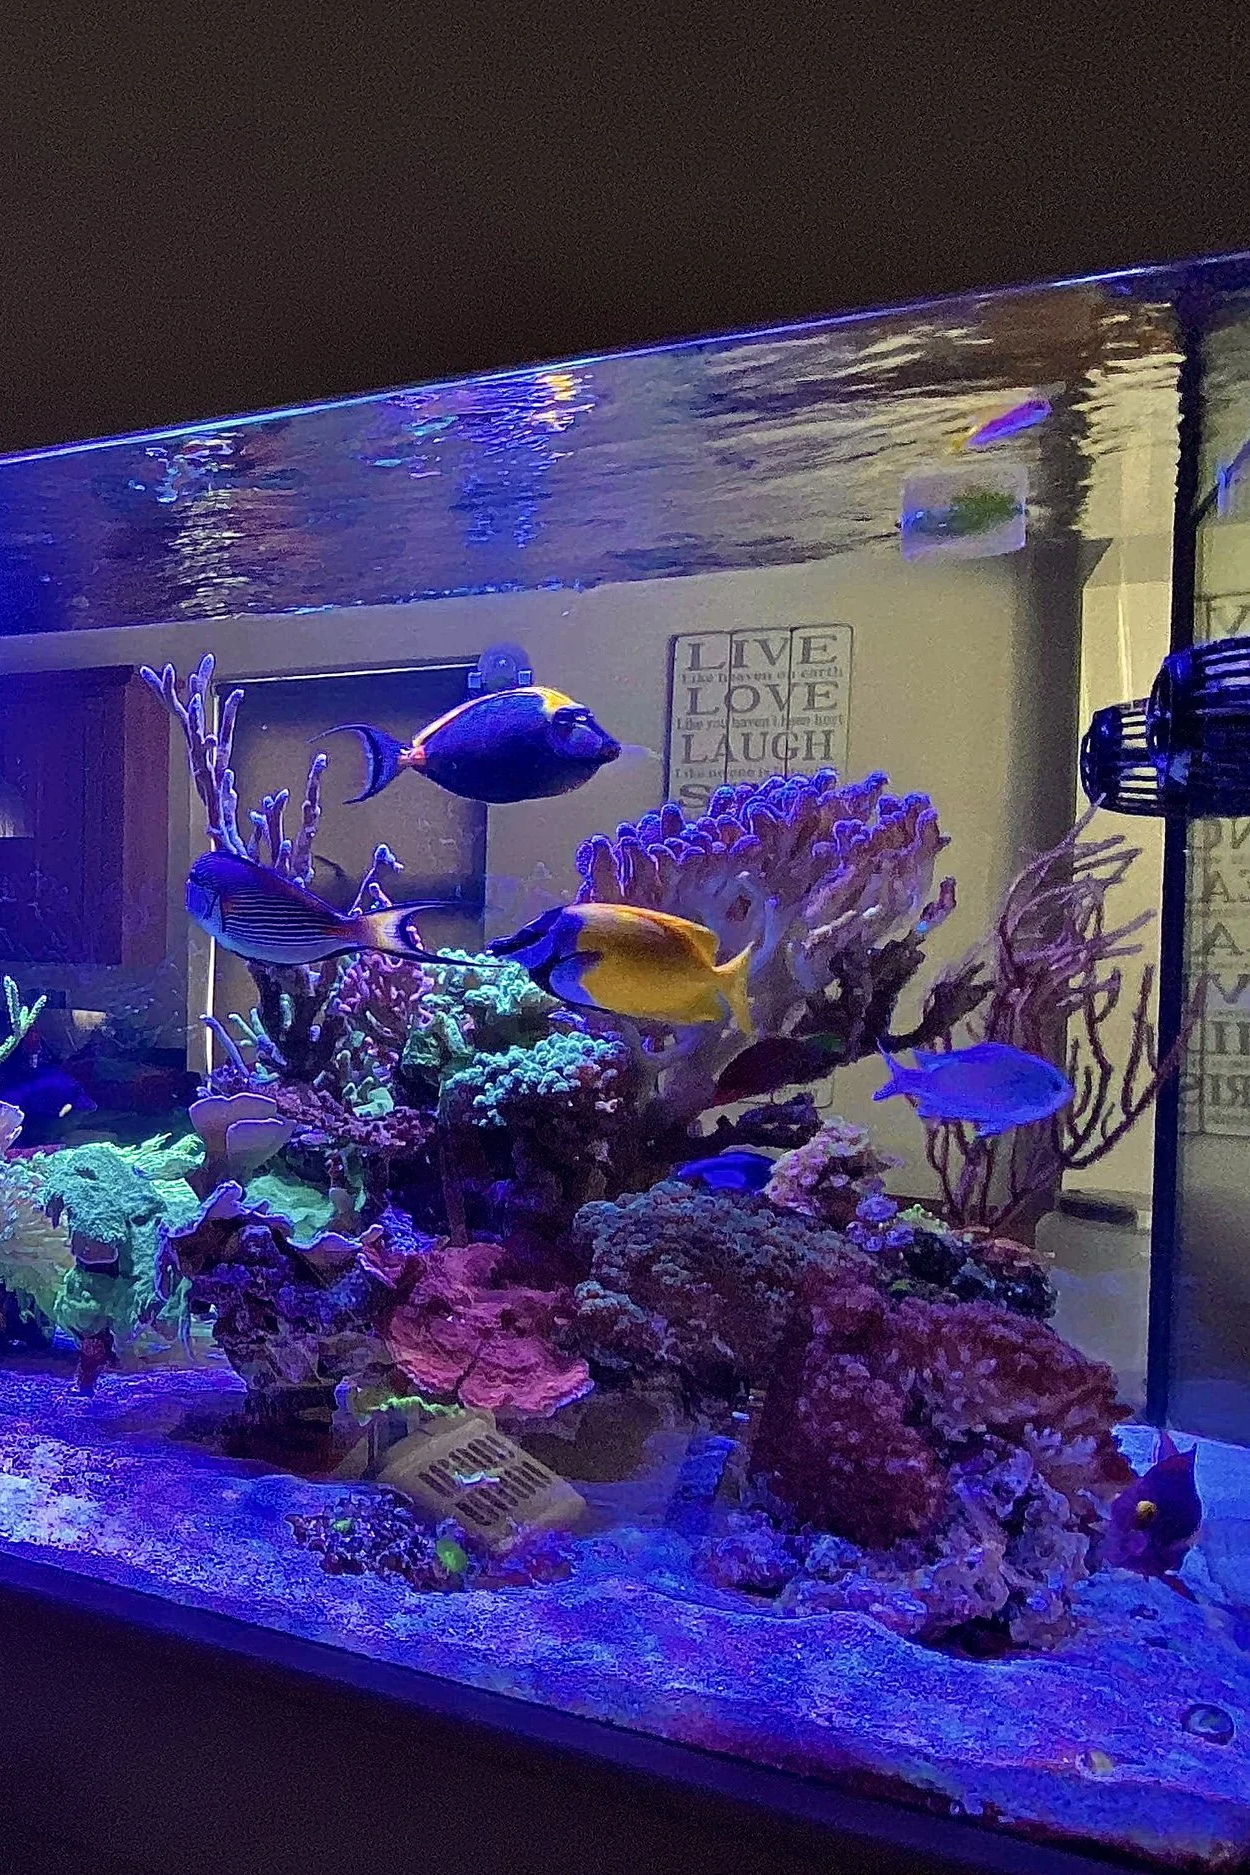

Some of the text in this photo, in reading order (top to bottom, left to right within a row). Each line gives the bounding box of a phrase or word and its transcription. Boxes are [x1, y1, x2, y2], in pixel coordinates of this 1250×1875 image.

[686, 634, 838, 671] LIVE
[801, 666, 843, 679] earth
[685, 681, 839, 716] LOVE
[681, 729, 835, 765] LAUGH
